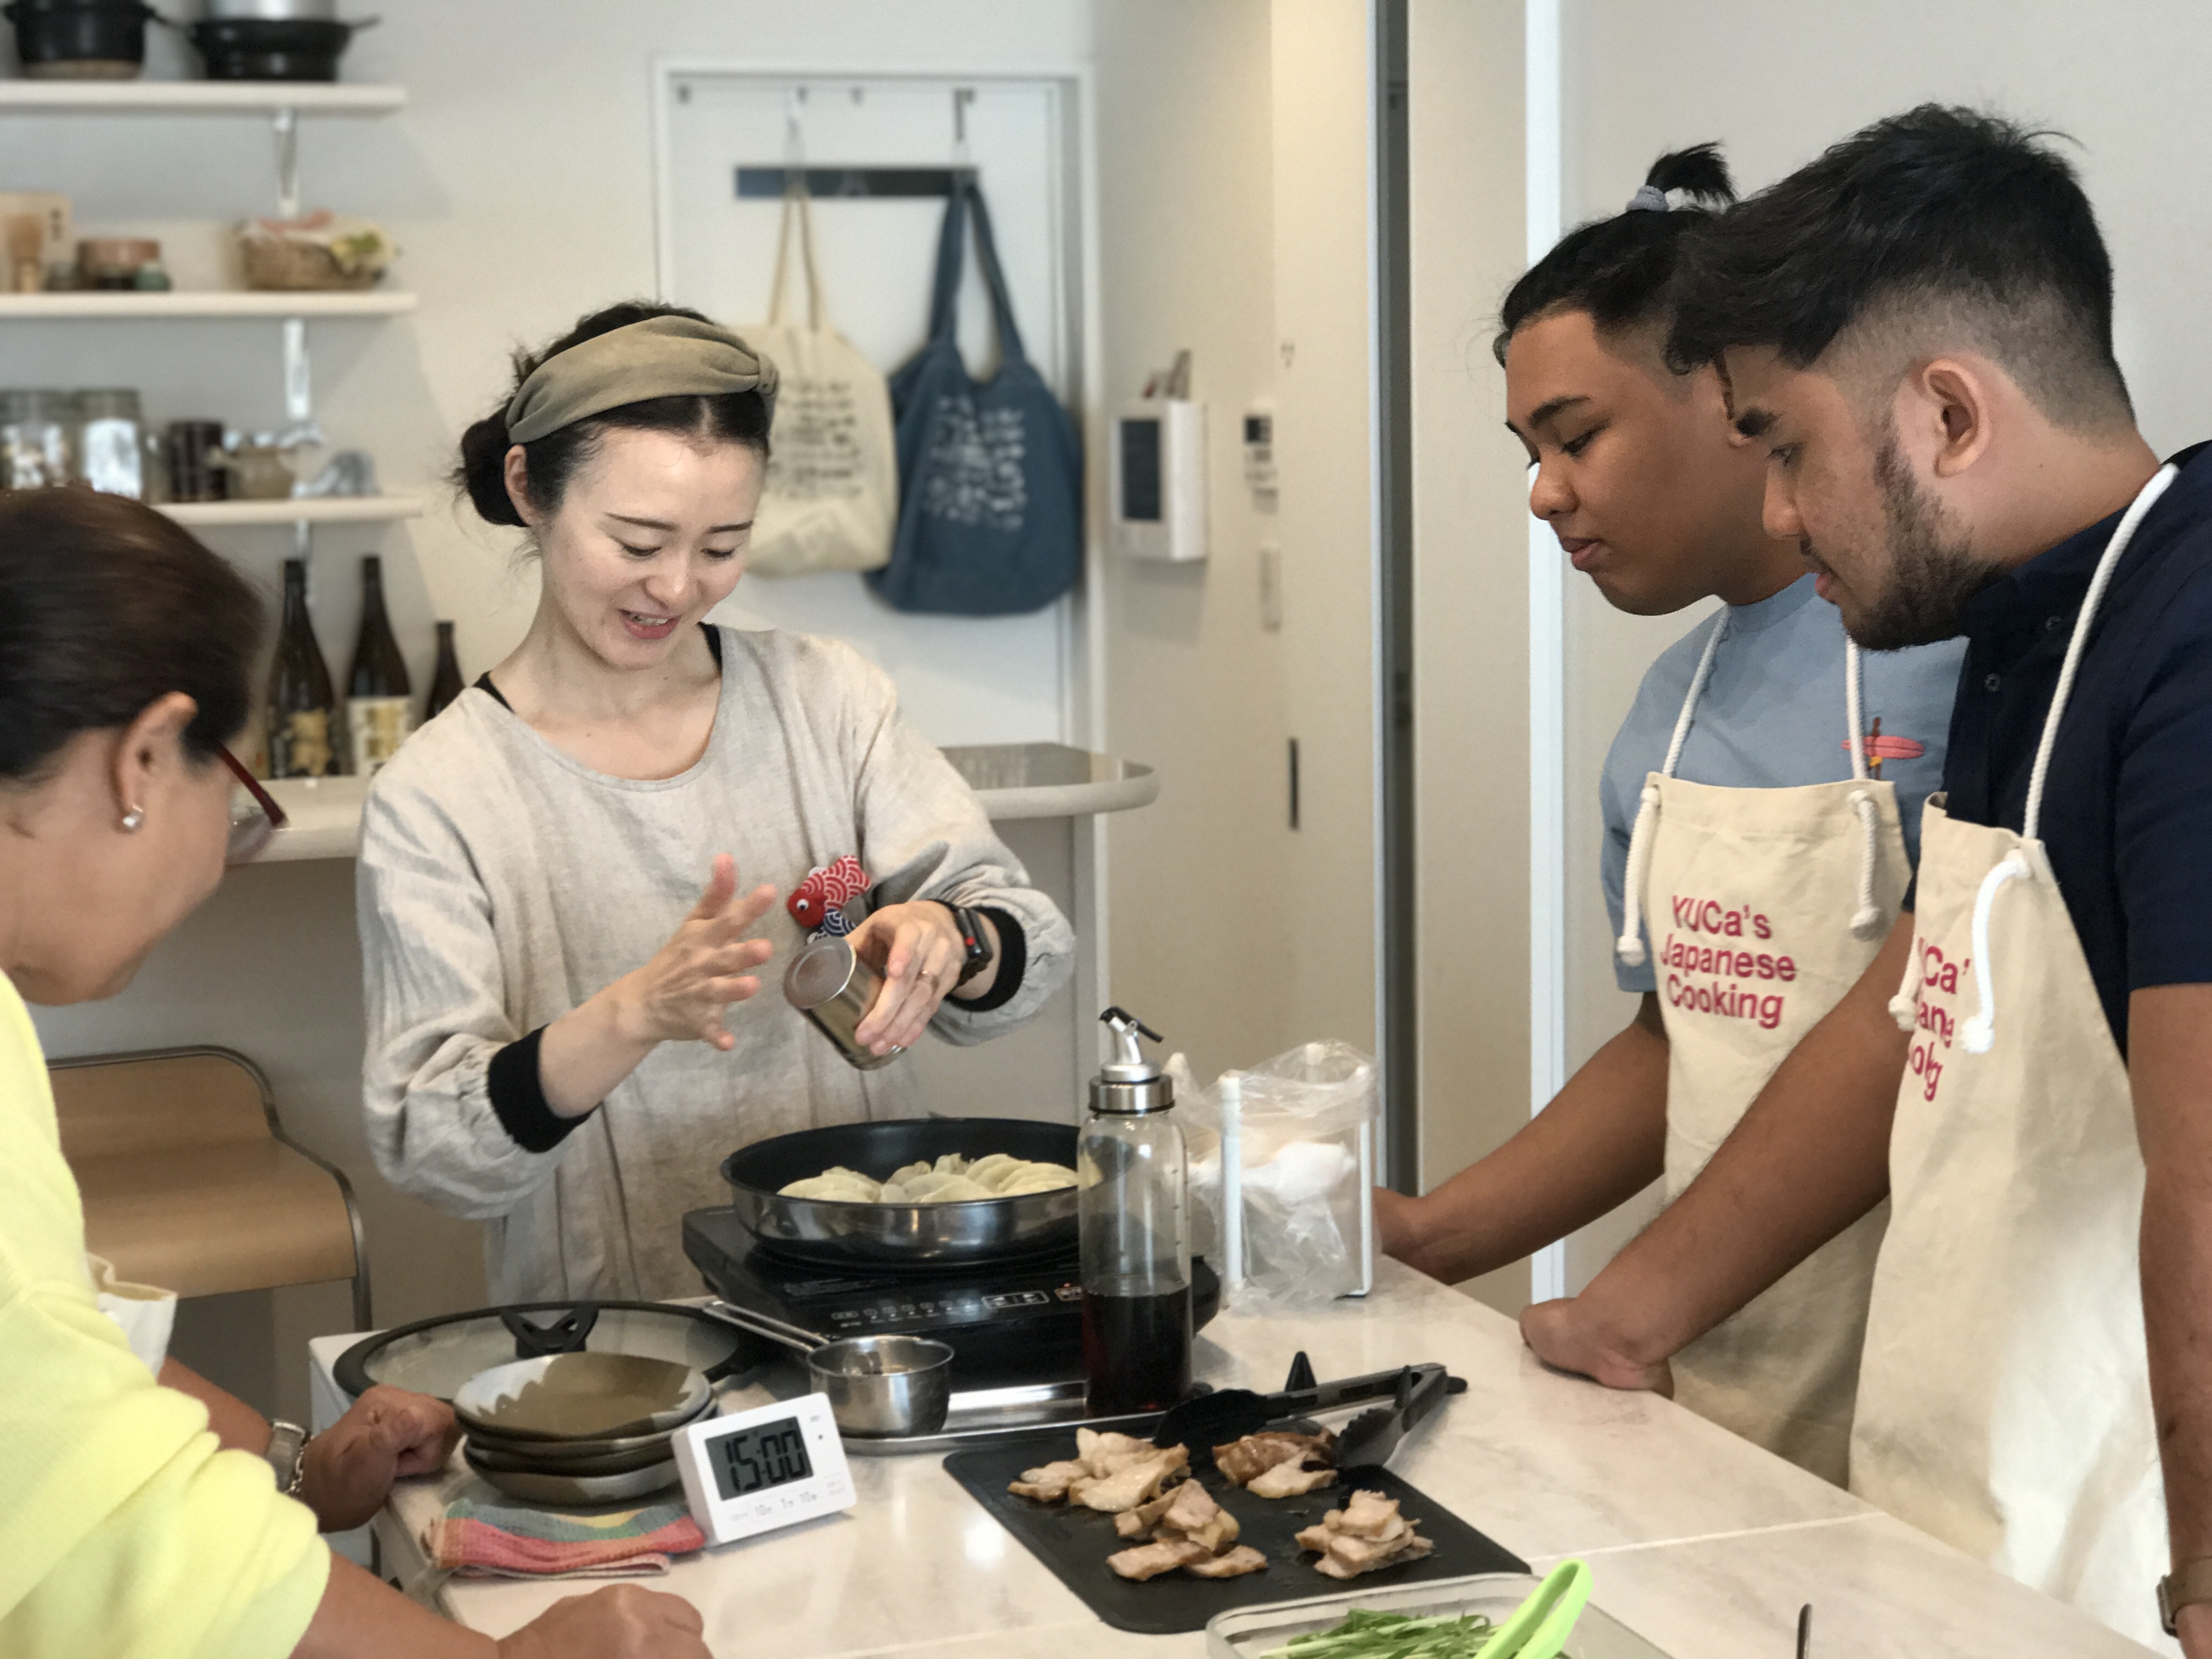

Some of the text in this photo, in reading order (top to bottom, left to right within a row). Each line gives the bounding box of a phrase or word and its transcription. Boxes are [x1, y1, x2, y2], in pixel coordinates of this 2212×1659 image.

[1660, 933, 1797, 981] Japanese
[1667, 974, 1785, 1029] Cooking
[725, 1429, 806, 1492] 15:00
